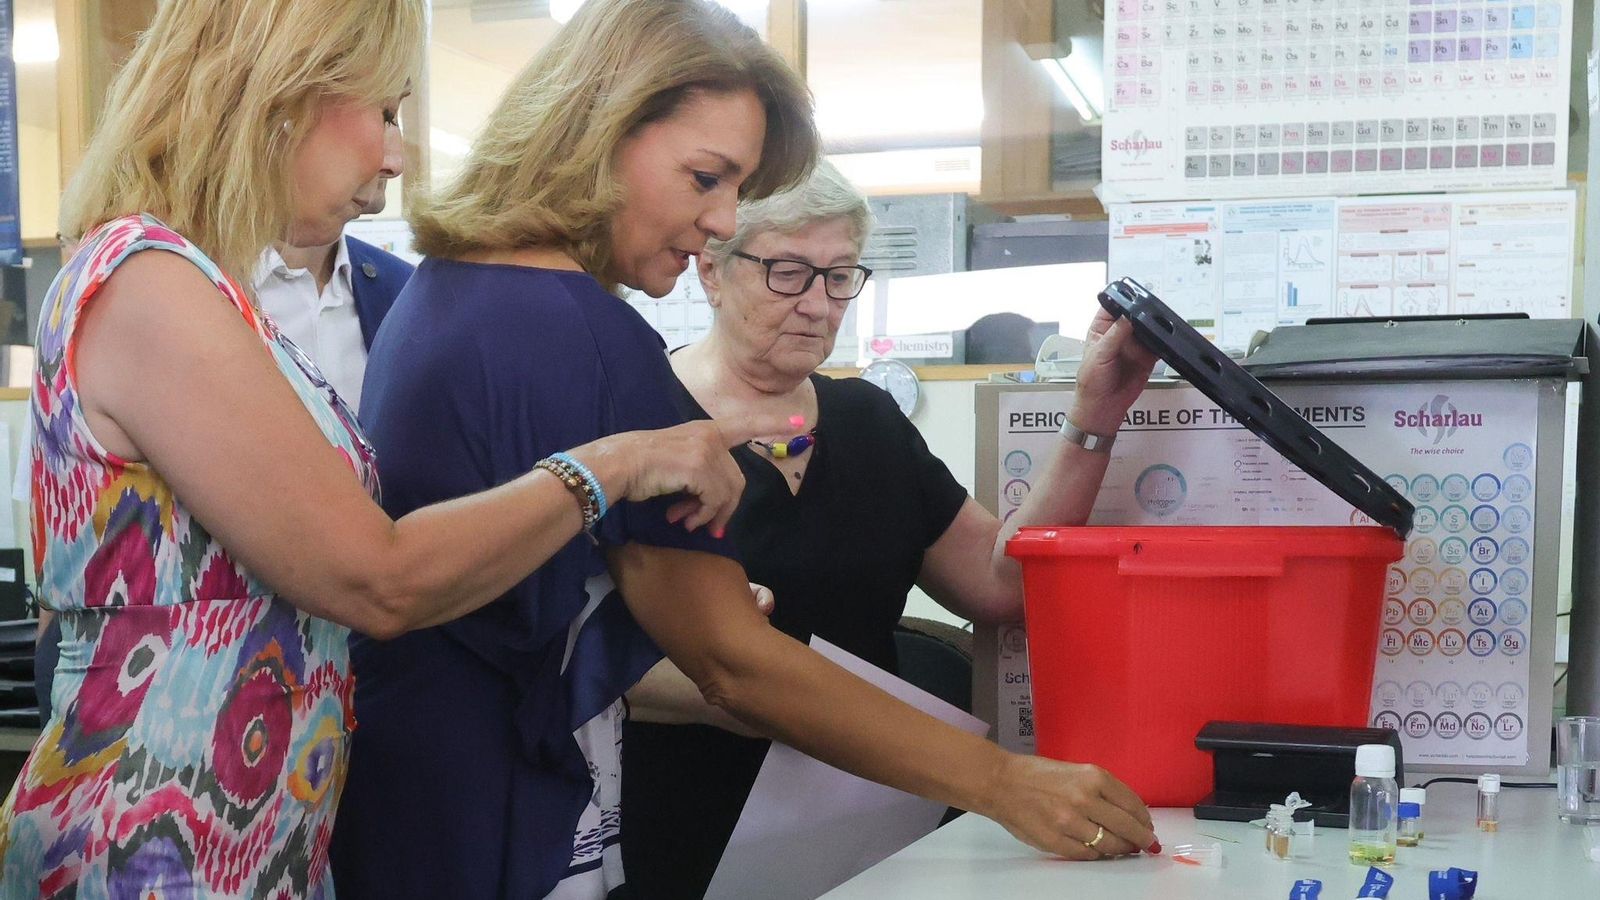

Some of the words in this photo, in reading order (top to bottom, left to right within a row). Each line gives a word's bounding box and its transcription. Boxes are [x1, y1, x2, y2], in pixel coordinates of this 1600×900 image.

[1385, 19, 1399, 27] Cd
[1110, 138, 1162, 151] Scharlau
[893, 339, 950, 354] chemistry
[1122, 410, 1170, 426] ABLE
[1177, 409, 1203, 424] OF
[1394, 408, 1482, 428] Scharlau
[1451, 515, 1458, 523] S
[1478, 546, 1491, 555] Br
[1445, 639, 1457, 647] Lv
[1504, 639, 1519, 650] Og
[1005, 672, 1030, 684] Sch
[1382, 721, 1394, 729] Es
[1410, 721, 1426, 730] Fm
[1440, 722, 1456, 731] Md
[1471, 722, 1485, 731] No
[1503, 723, 1514, 732] Lr
